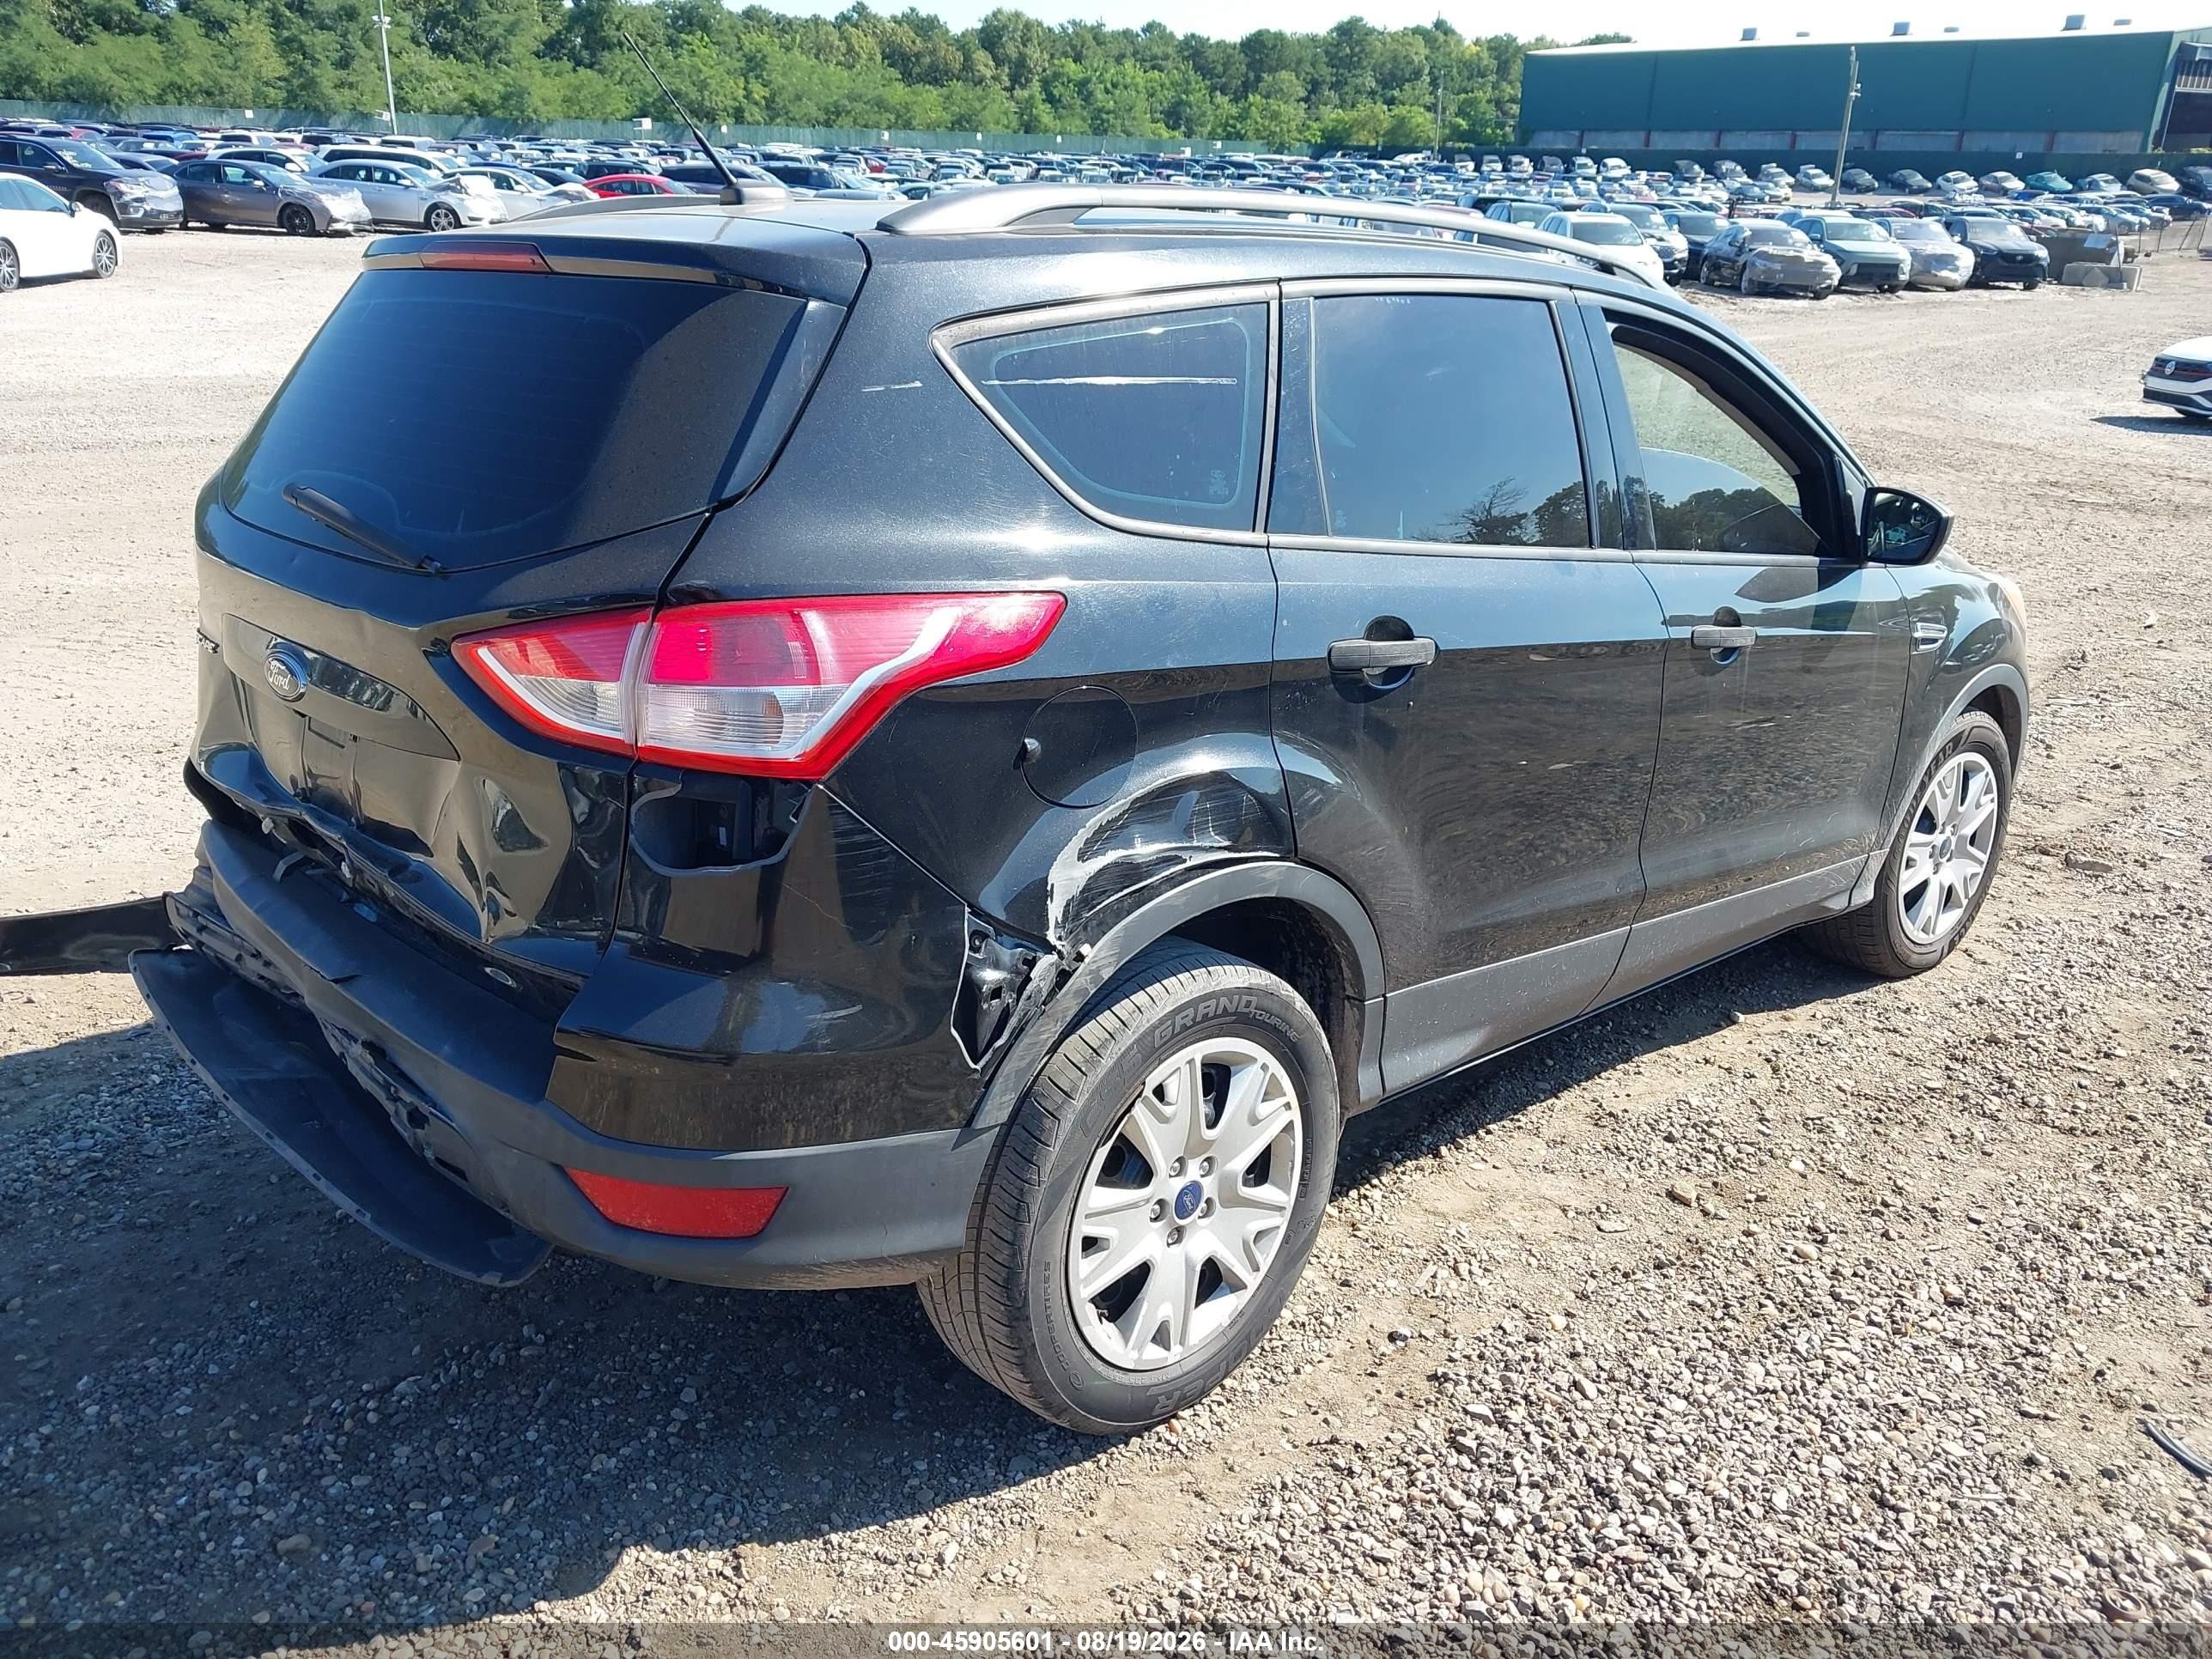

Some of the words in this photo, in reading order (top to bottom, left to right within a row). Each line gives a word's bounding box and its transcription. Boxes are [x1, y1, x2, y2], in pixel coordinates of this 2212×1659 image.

[268, 660, 291, 690] Ford
[1153, 995, 1257, 1048] GRAND
[1249, 1009, 1300, 1042] TOURING
